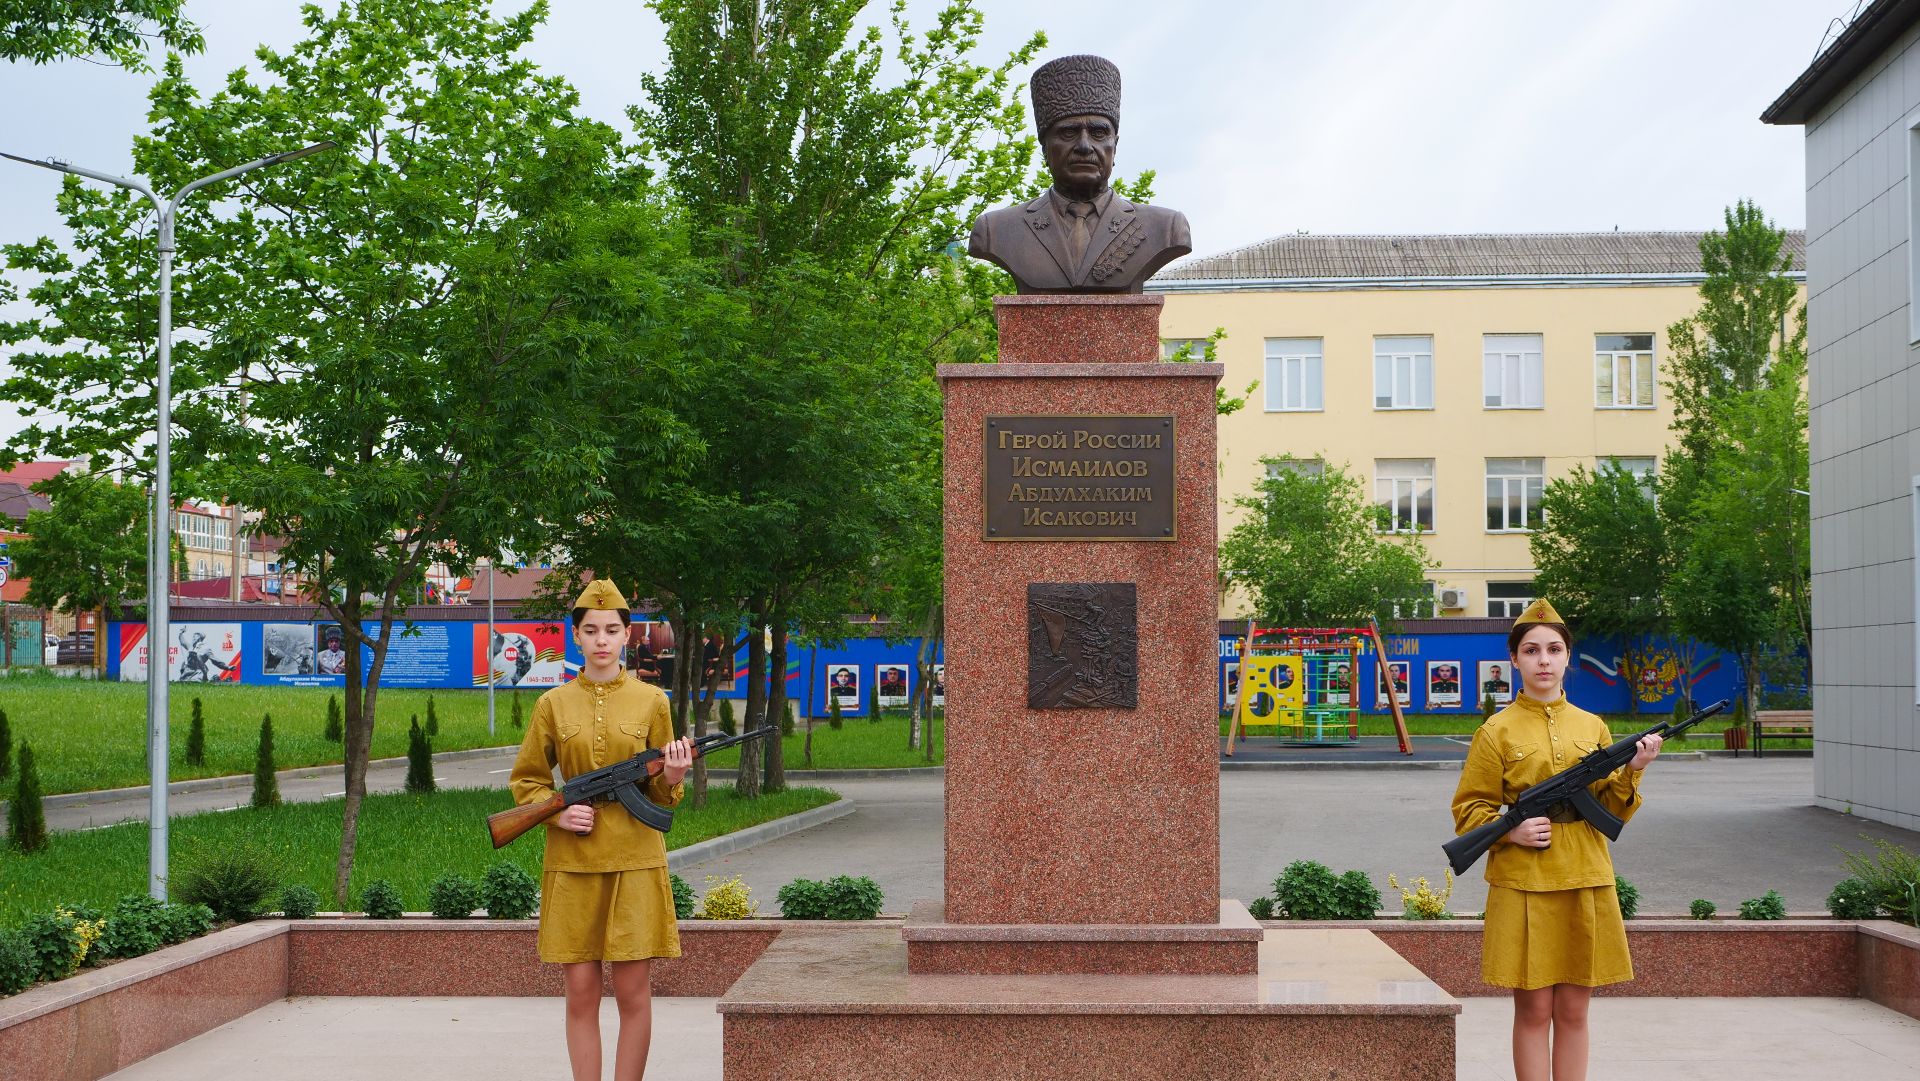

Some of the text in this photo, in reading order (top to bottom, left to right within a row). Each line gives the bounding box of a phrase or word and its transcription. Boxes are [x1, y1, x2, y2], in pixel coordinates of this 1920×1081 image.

[998, 430, 1161, 449] ГЕРОЙ РОССИИ
[1012, 456, 1148, 477] ИСМАИЛОВ
[1008, 483, 1152, 503] АБДУЛХАКИМ
[1023, 507, 1137, 526] ИСАКОВИЧ
